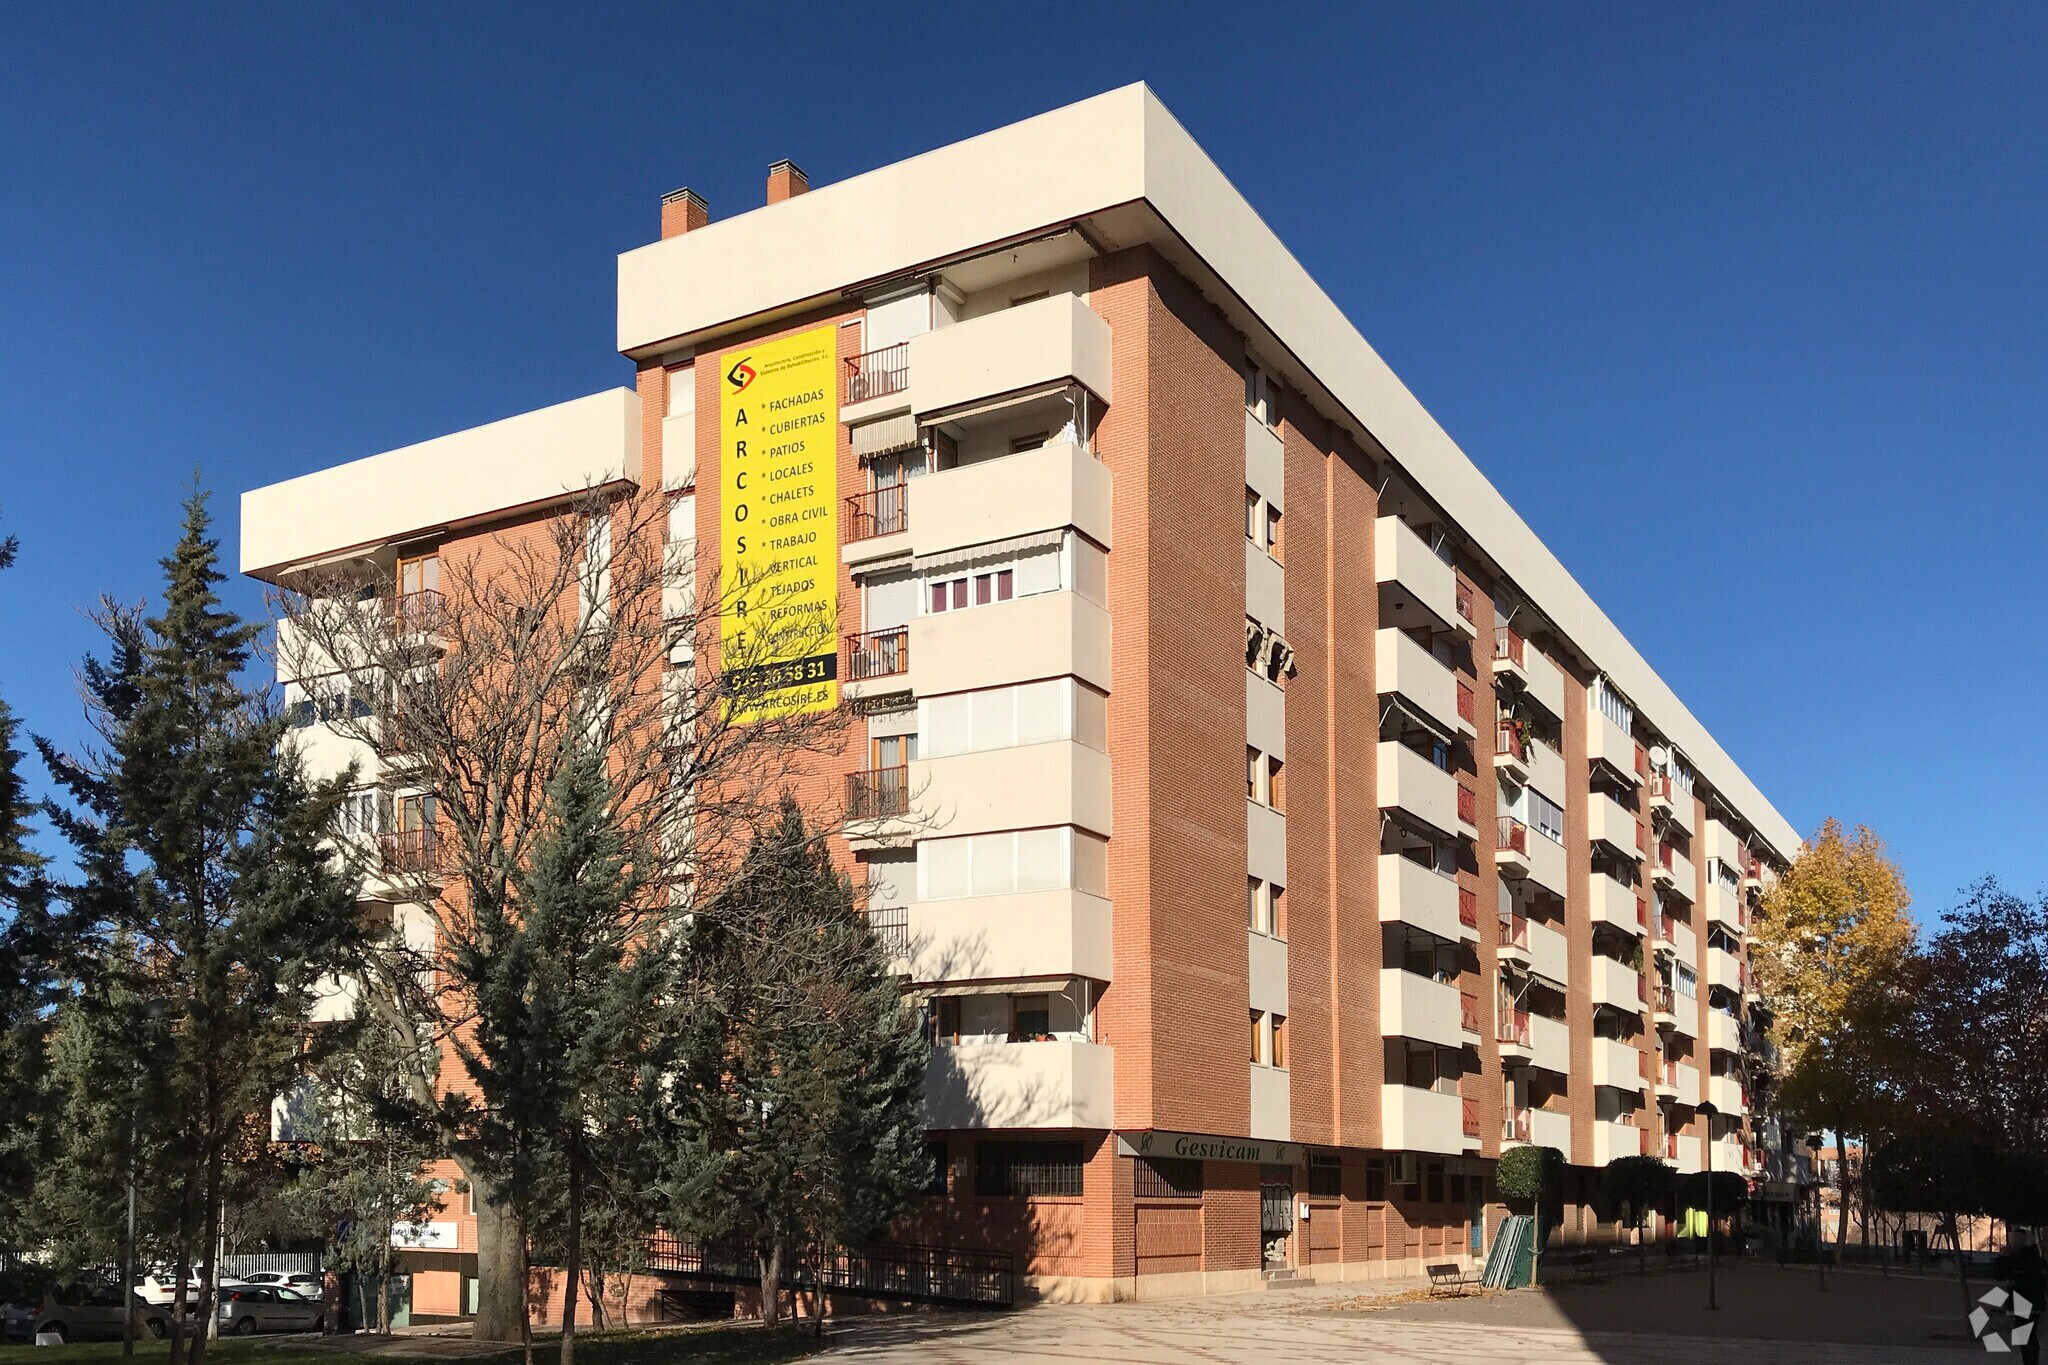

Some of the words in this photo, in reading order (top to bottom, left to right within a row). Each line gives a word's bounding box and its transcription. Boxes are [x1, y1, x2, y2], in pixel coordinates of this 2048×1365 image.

[769, 388, 825, 413] FACHADAS
[769, 412, 826, 435] CUBIERTAS
[769, 440, 806, 459] PATIOS
[769, 462, 814, 482] LOCALES
[769, 485, 815, 505] CHALETS
[769, 513, 799, 528] OBRA
[801, 505, 829, 523] CIVIL
[770, 531, 818, 551] TRABAJO
[770, 555, 819, 574] VERTICAL
[770, 578, 816, 598] TEJADOS
[770, 599, 828, 620] REFORMAS
[807, 660, 826, 679] 31
[1175, 1136, 1261, 1161] Gesvicam
